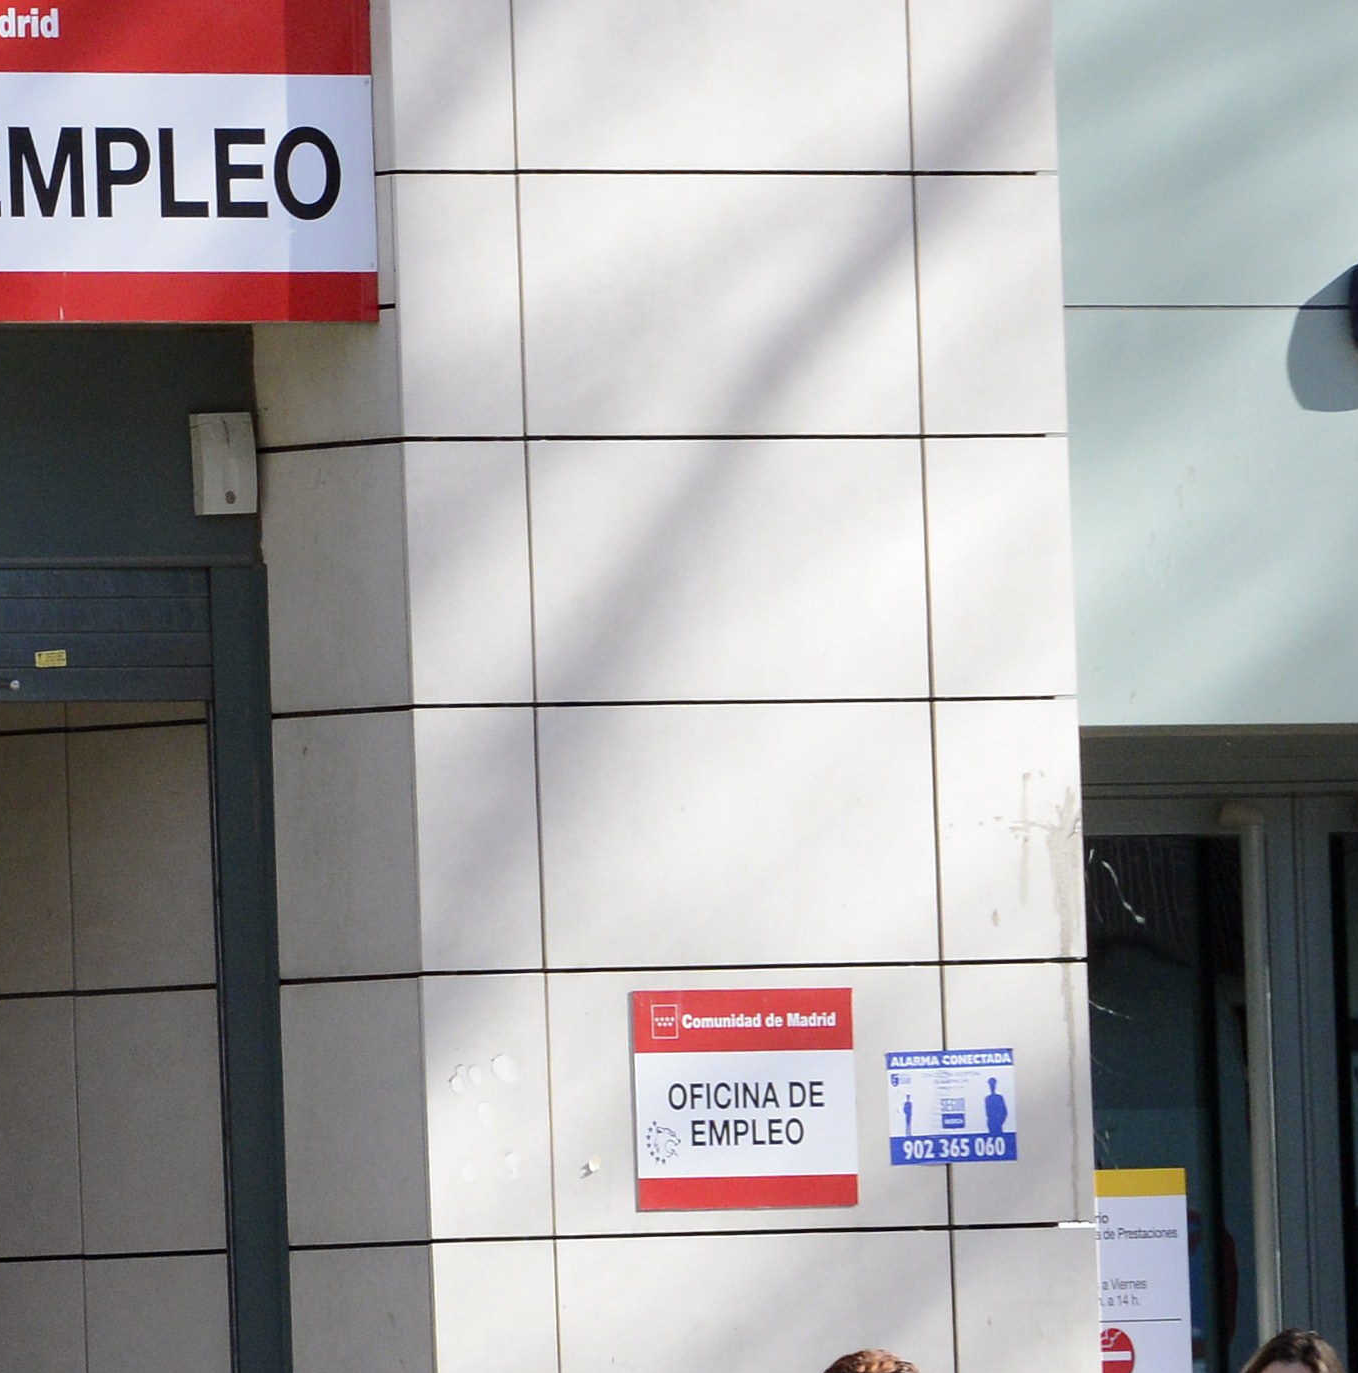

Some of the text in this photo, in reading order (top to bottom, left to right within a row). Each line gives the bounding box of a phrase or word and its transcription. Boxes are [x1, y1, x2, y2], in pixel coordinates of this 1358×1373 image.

[682, 1012, 836, 1029] Comunidad de Madrid
[890, 1053, 1011, 1067] ALARMA CONECTADA
[668, 1081, 825, 1110] OFICINA DE
[691, 1118, 804, 1146] EMPLEO
[903, 1137, 1006, 1160] 902 365 060
[1103, 1228, 1115, 1240] de
[1117, 1227, 1178, 1239] Prestaciones
[1110, 1278, 1147, 1290] Viernes
